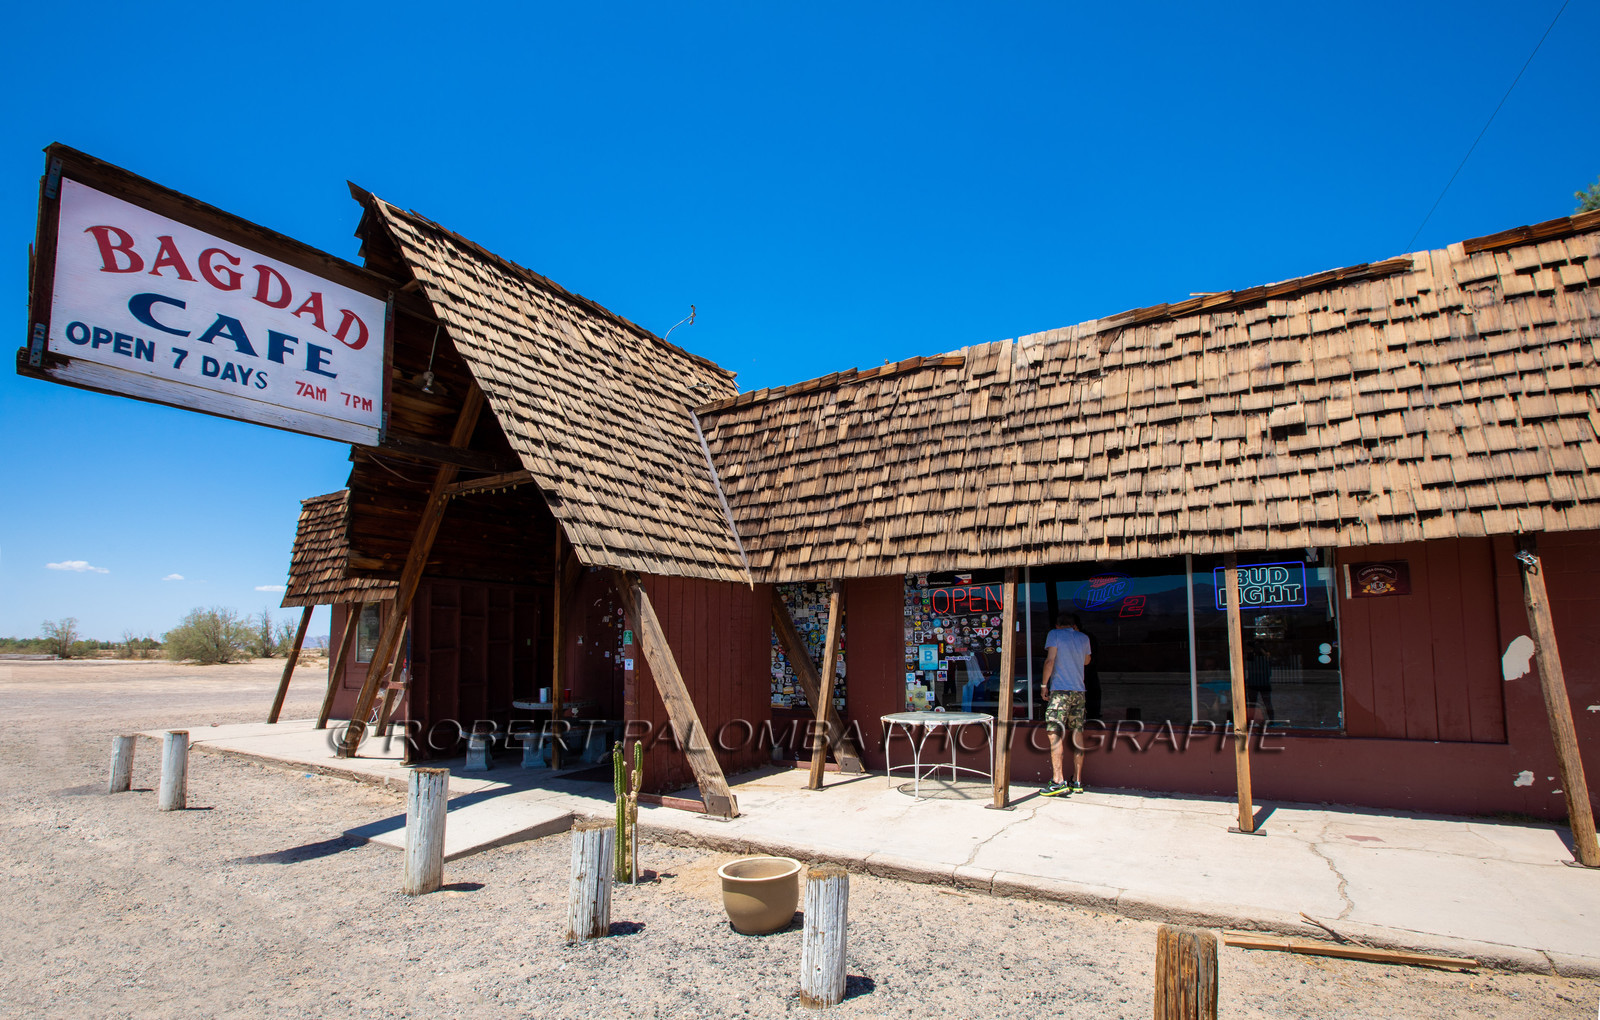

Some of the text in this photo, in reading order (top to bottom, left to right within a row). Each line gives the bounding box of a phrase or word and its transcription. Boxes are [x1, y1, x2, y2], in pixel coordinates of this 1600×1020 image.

[84, 224, 369, 351] BAGDAD
[127, 292, 338, 380] CAFE
[65, 320, 269, 390] OPEN 7 DAYS
[294, 380, 374, 413] 7AM 7PM
[932, 584, 1003, 613] OPEN
[1118, 594, 1147, 618] 2
[924, 650, 933, 661] B
